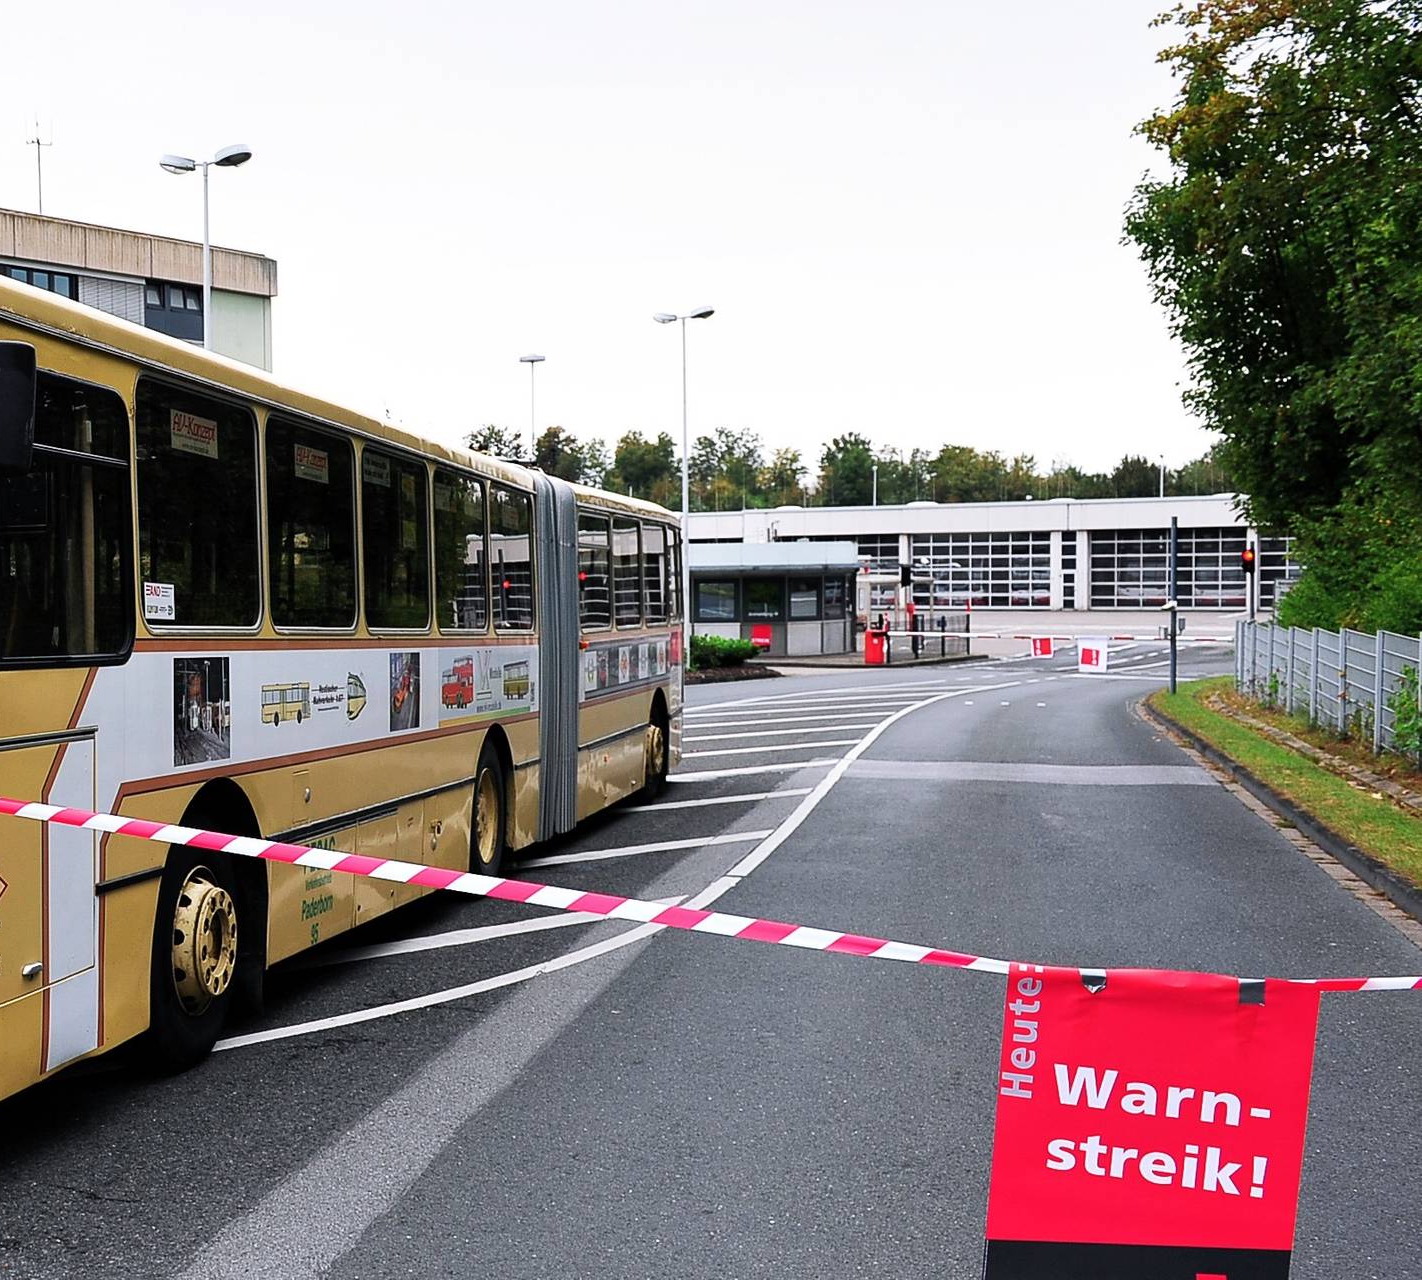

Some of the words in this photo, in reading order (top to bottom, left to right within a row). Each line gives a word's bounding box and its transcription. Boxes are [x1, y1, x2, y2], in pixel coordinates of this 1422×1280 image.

[1000, 963, 1043, 1099] Heute:
[1053, 1063, 1271, 1126] Warn-
[1045, 1135, 1268, 1199] streik!
